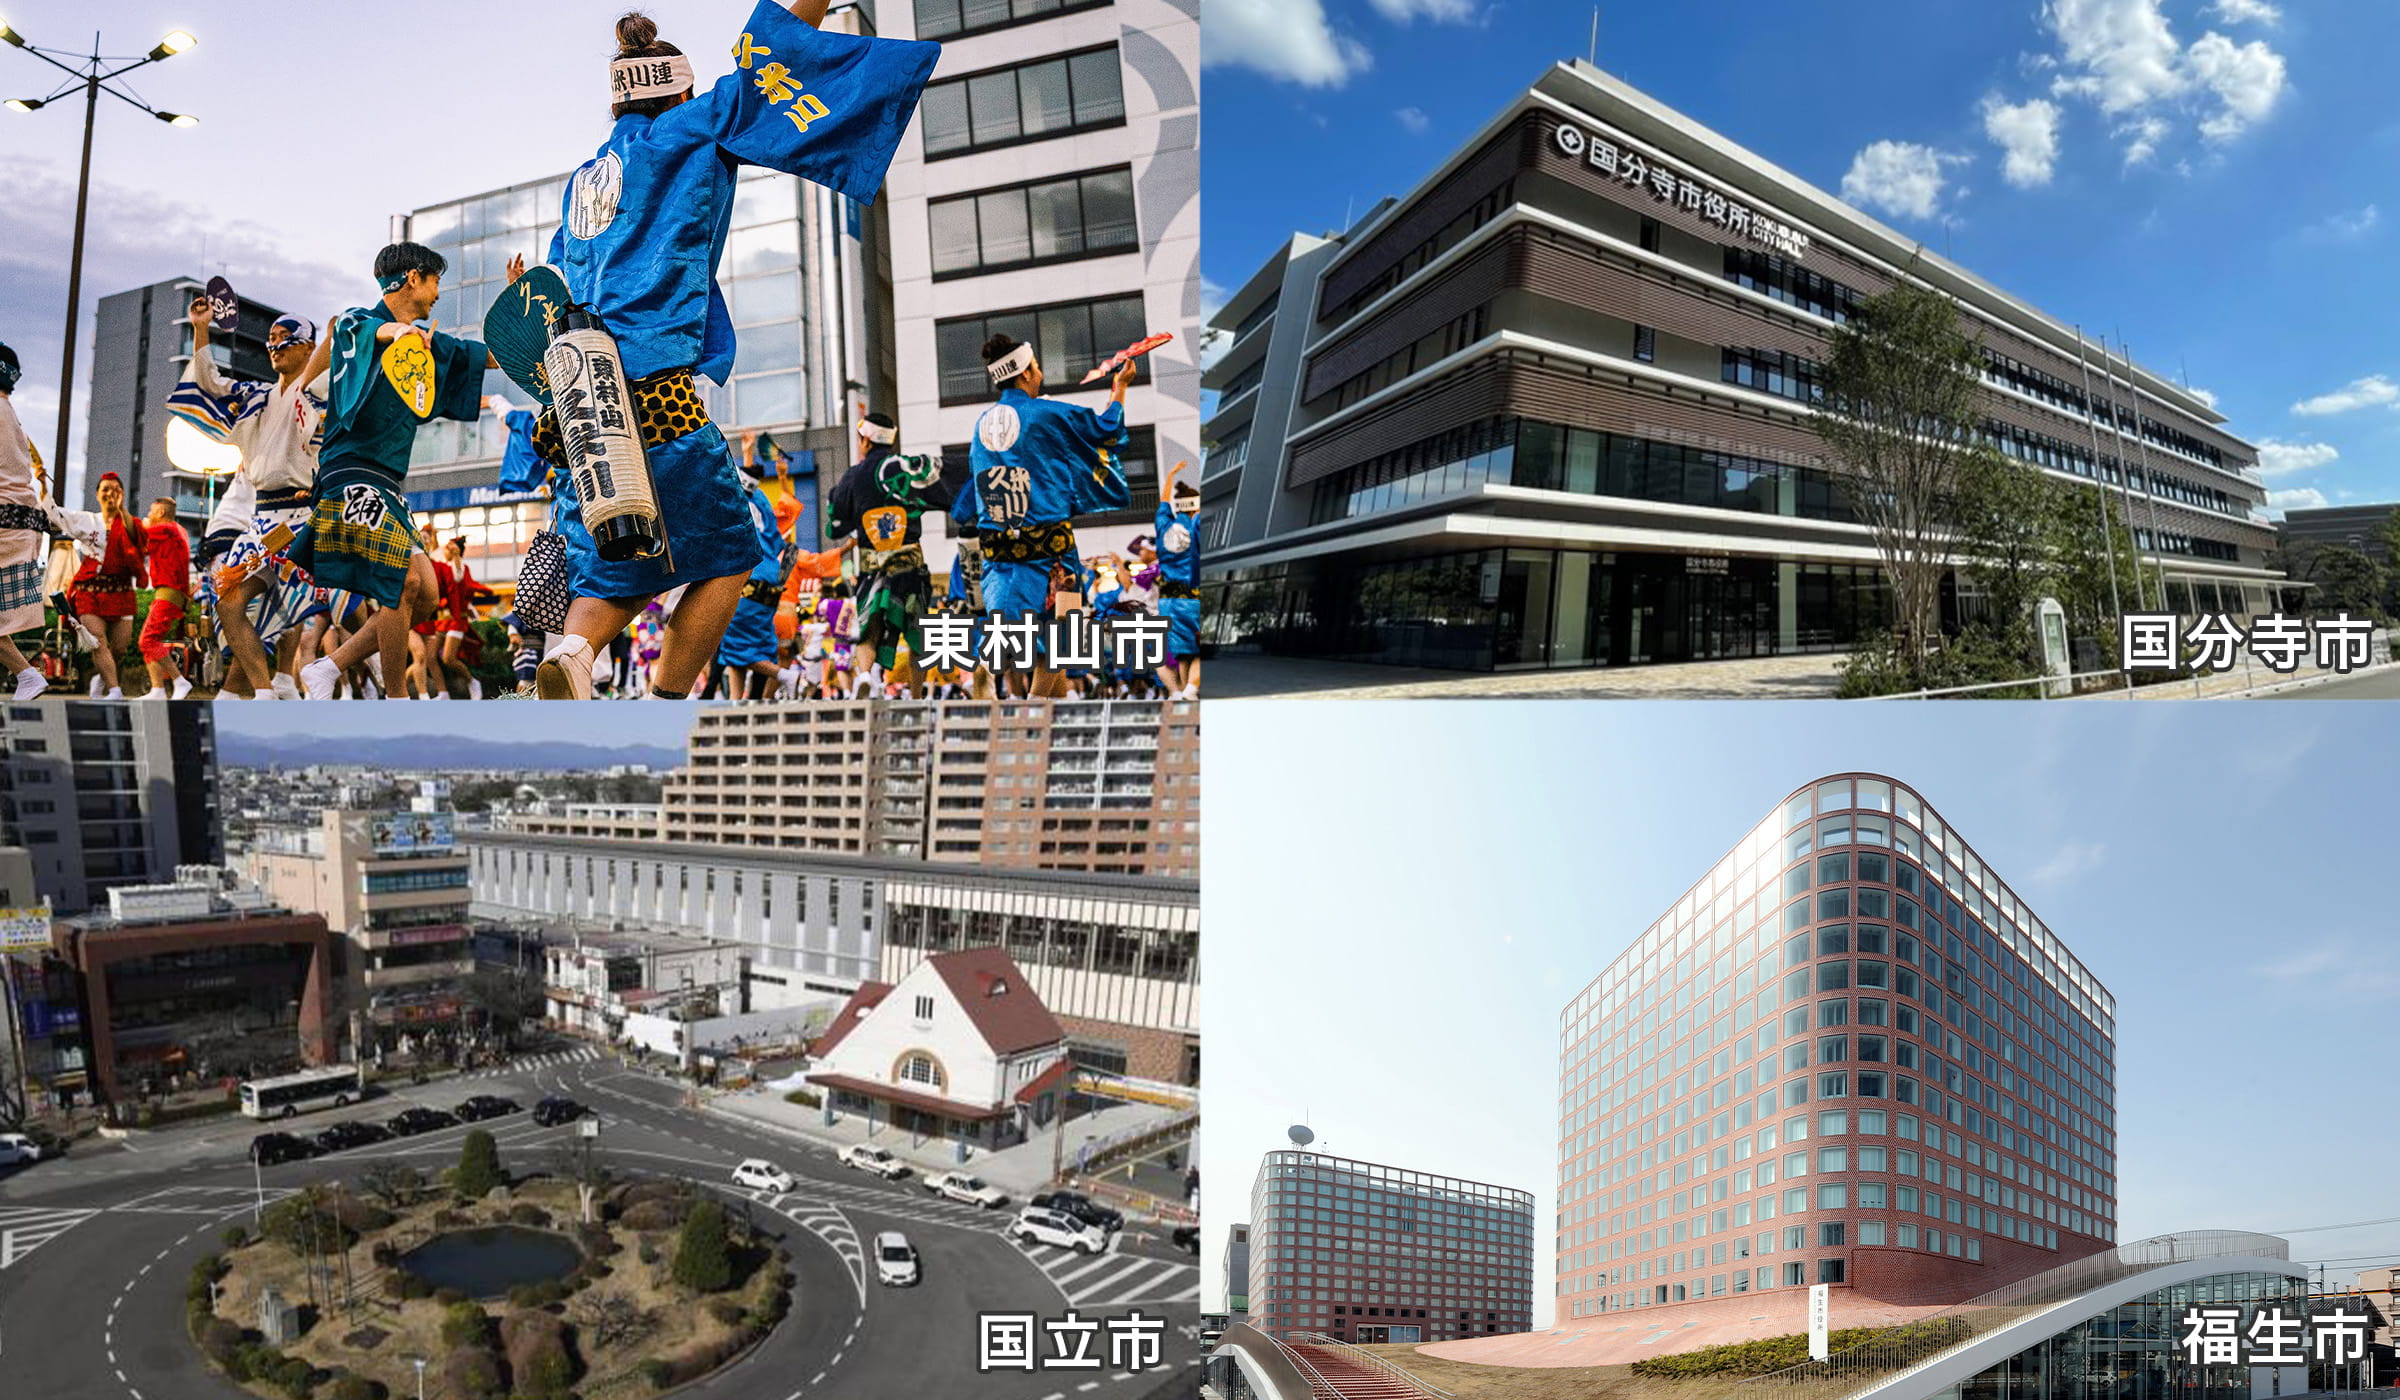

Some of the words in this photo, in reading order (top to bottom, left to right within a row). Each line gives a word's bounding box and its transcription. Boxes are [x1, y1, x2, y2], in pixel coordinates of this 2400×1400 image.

[611, 61, 674, 92] 米川連
[1589, 136, 1750, 234] 国分寺市役所
[1752, 225, 1776, 245] CITY
[1775, 235, 1803, 258] HALL
[591, 355, 626, 430] 東村山
